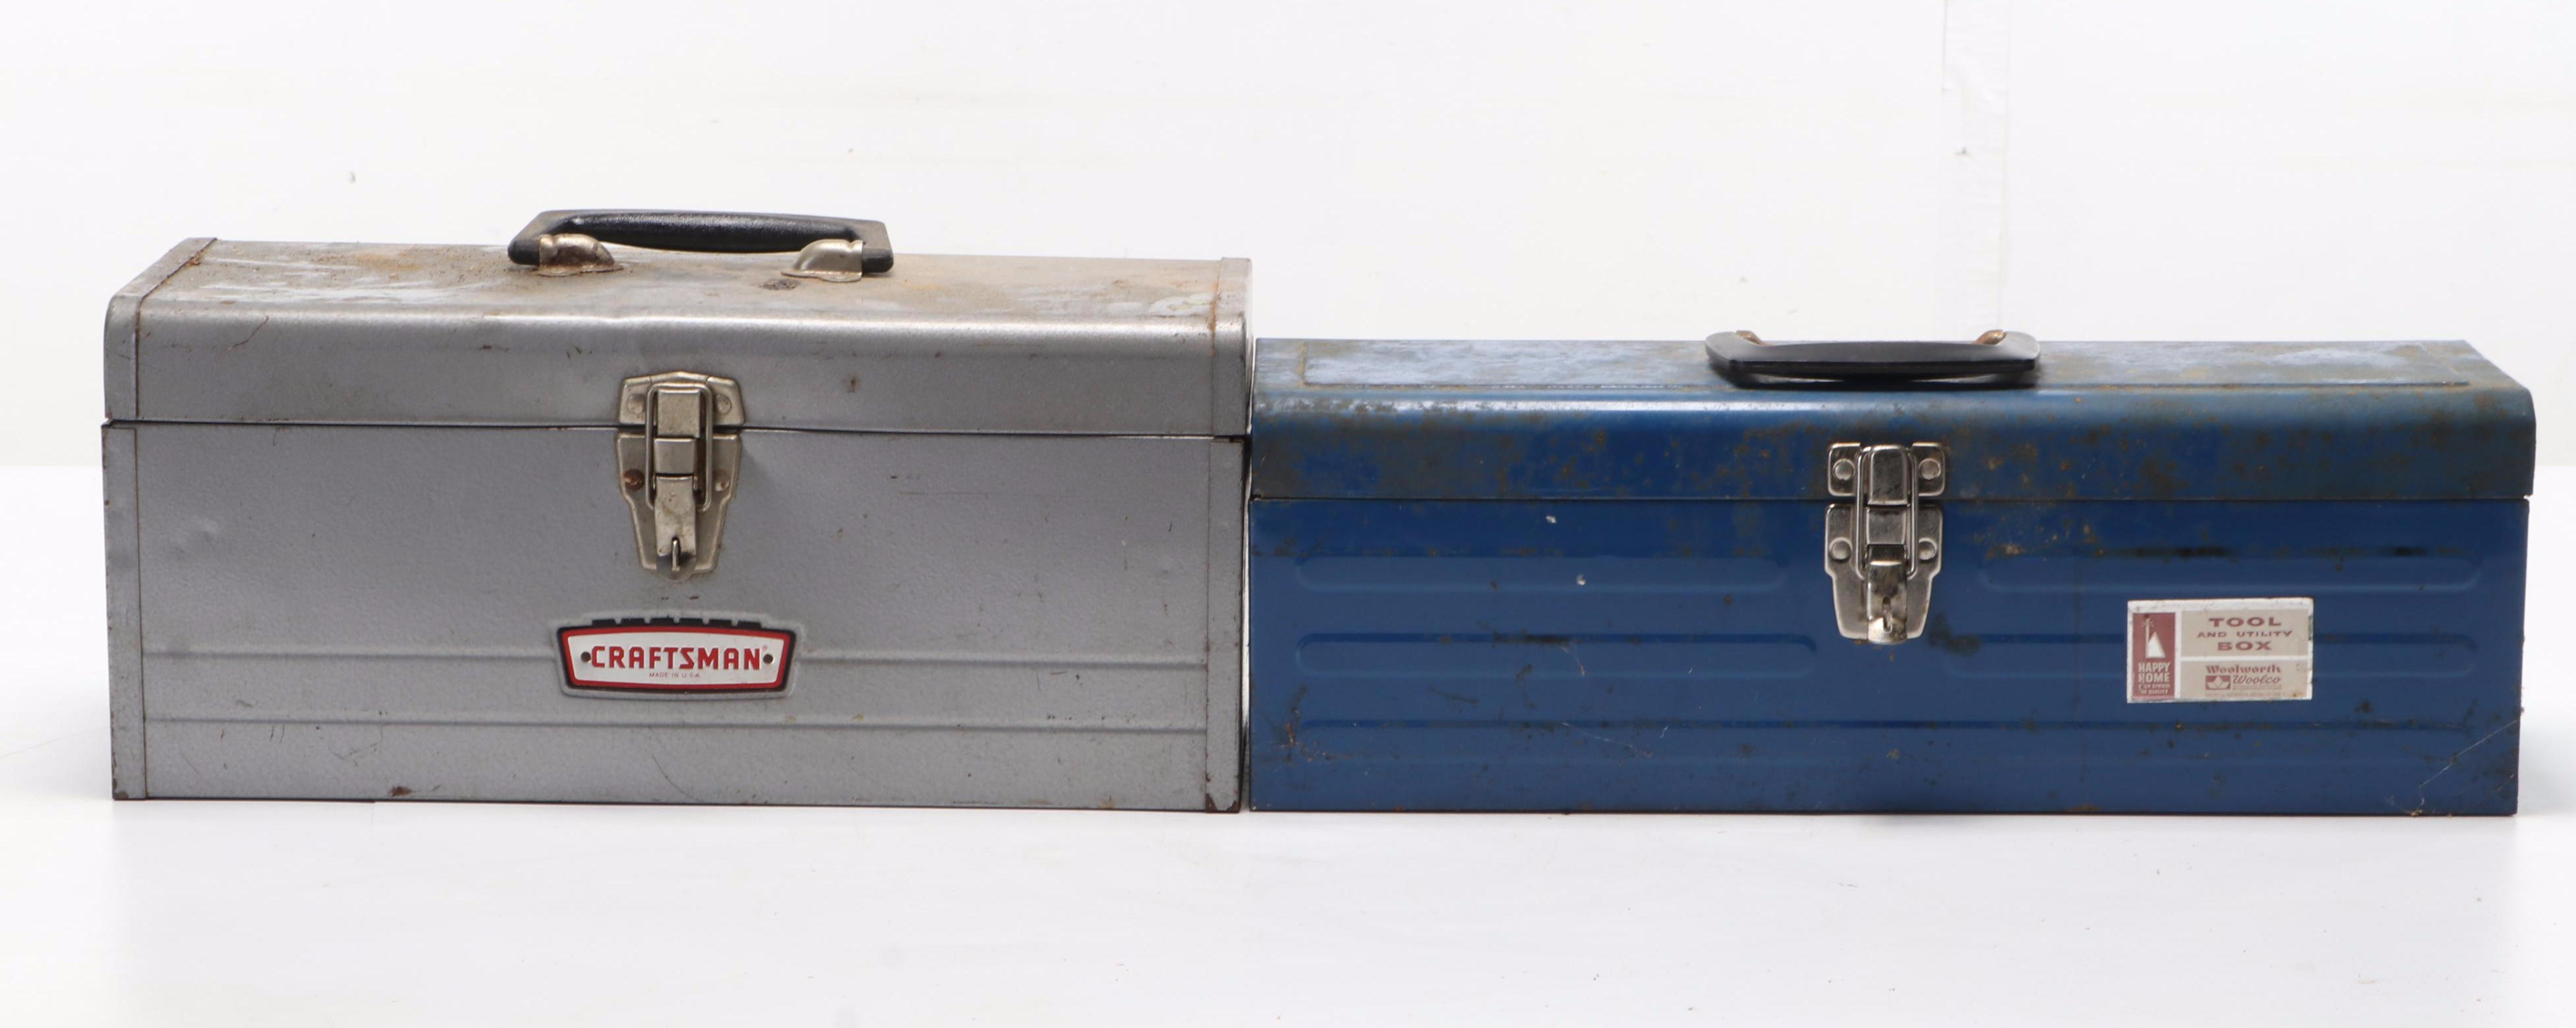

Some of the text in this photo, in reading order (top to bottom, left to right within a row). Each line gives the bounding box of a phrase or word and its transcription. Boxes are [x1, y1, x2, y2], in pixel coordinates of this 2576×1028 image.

[2208, 617, 2282, 627] TOOL
[2217, 641, 2271, 651] BOX
[591, 646, 760, 670] CRAFTSMAN
[2138, 662, 2171, 672] HAPPY
[2206, 664, 2281, 673] Woolworth
[2138, 673, 2170, 683] HOME
[2233, 675, 2281, 684] Woolco
